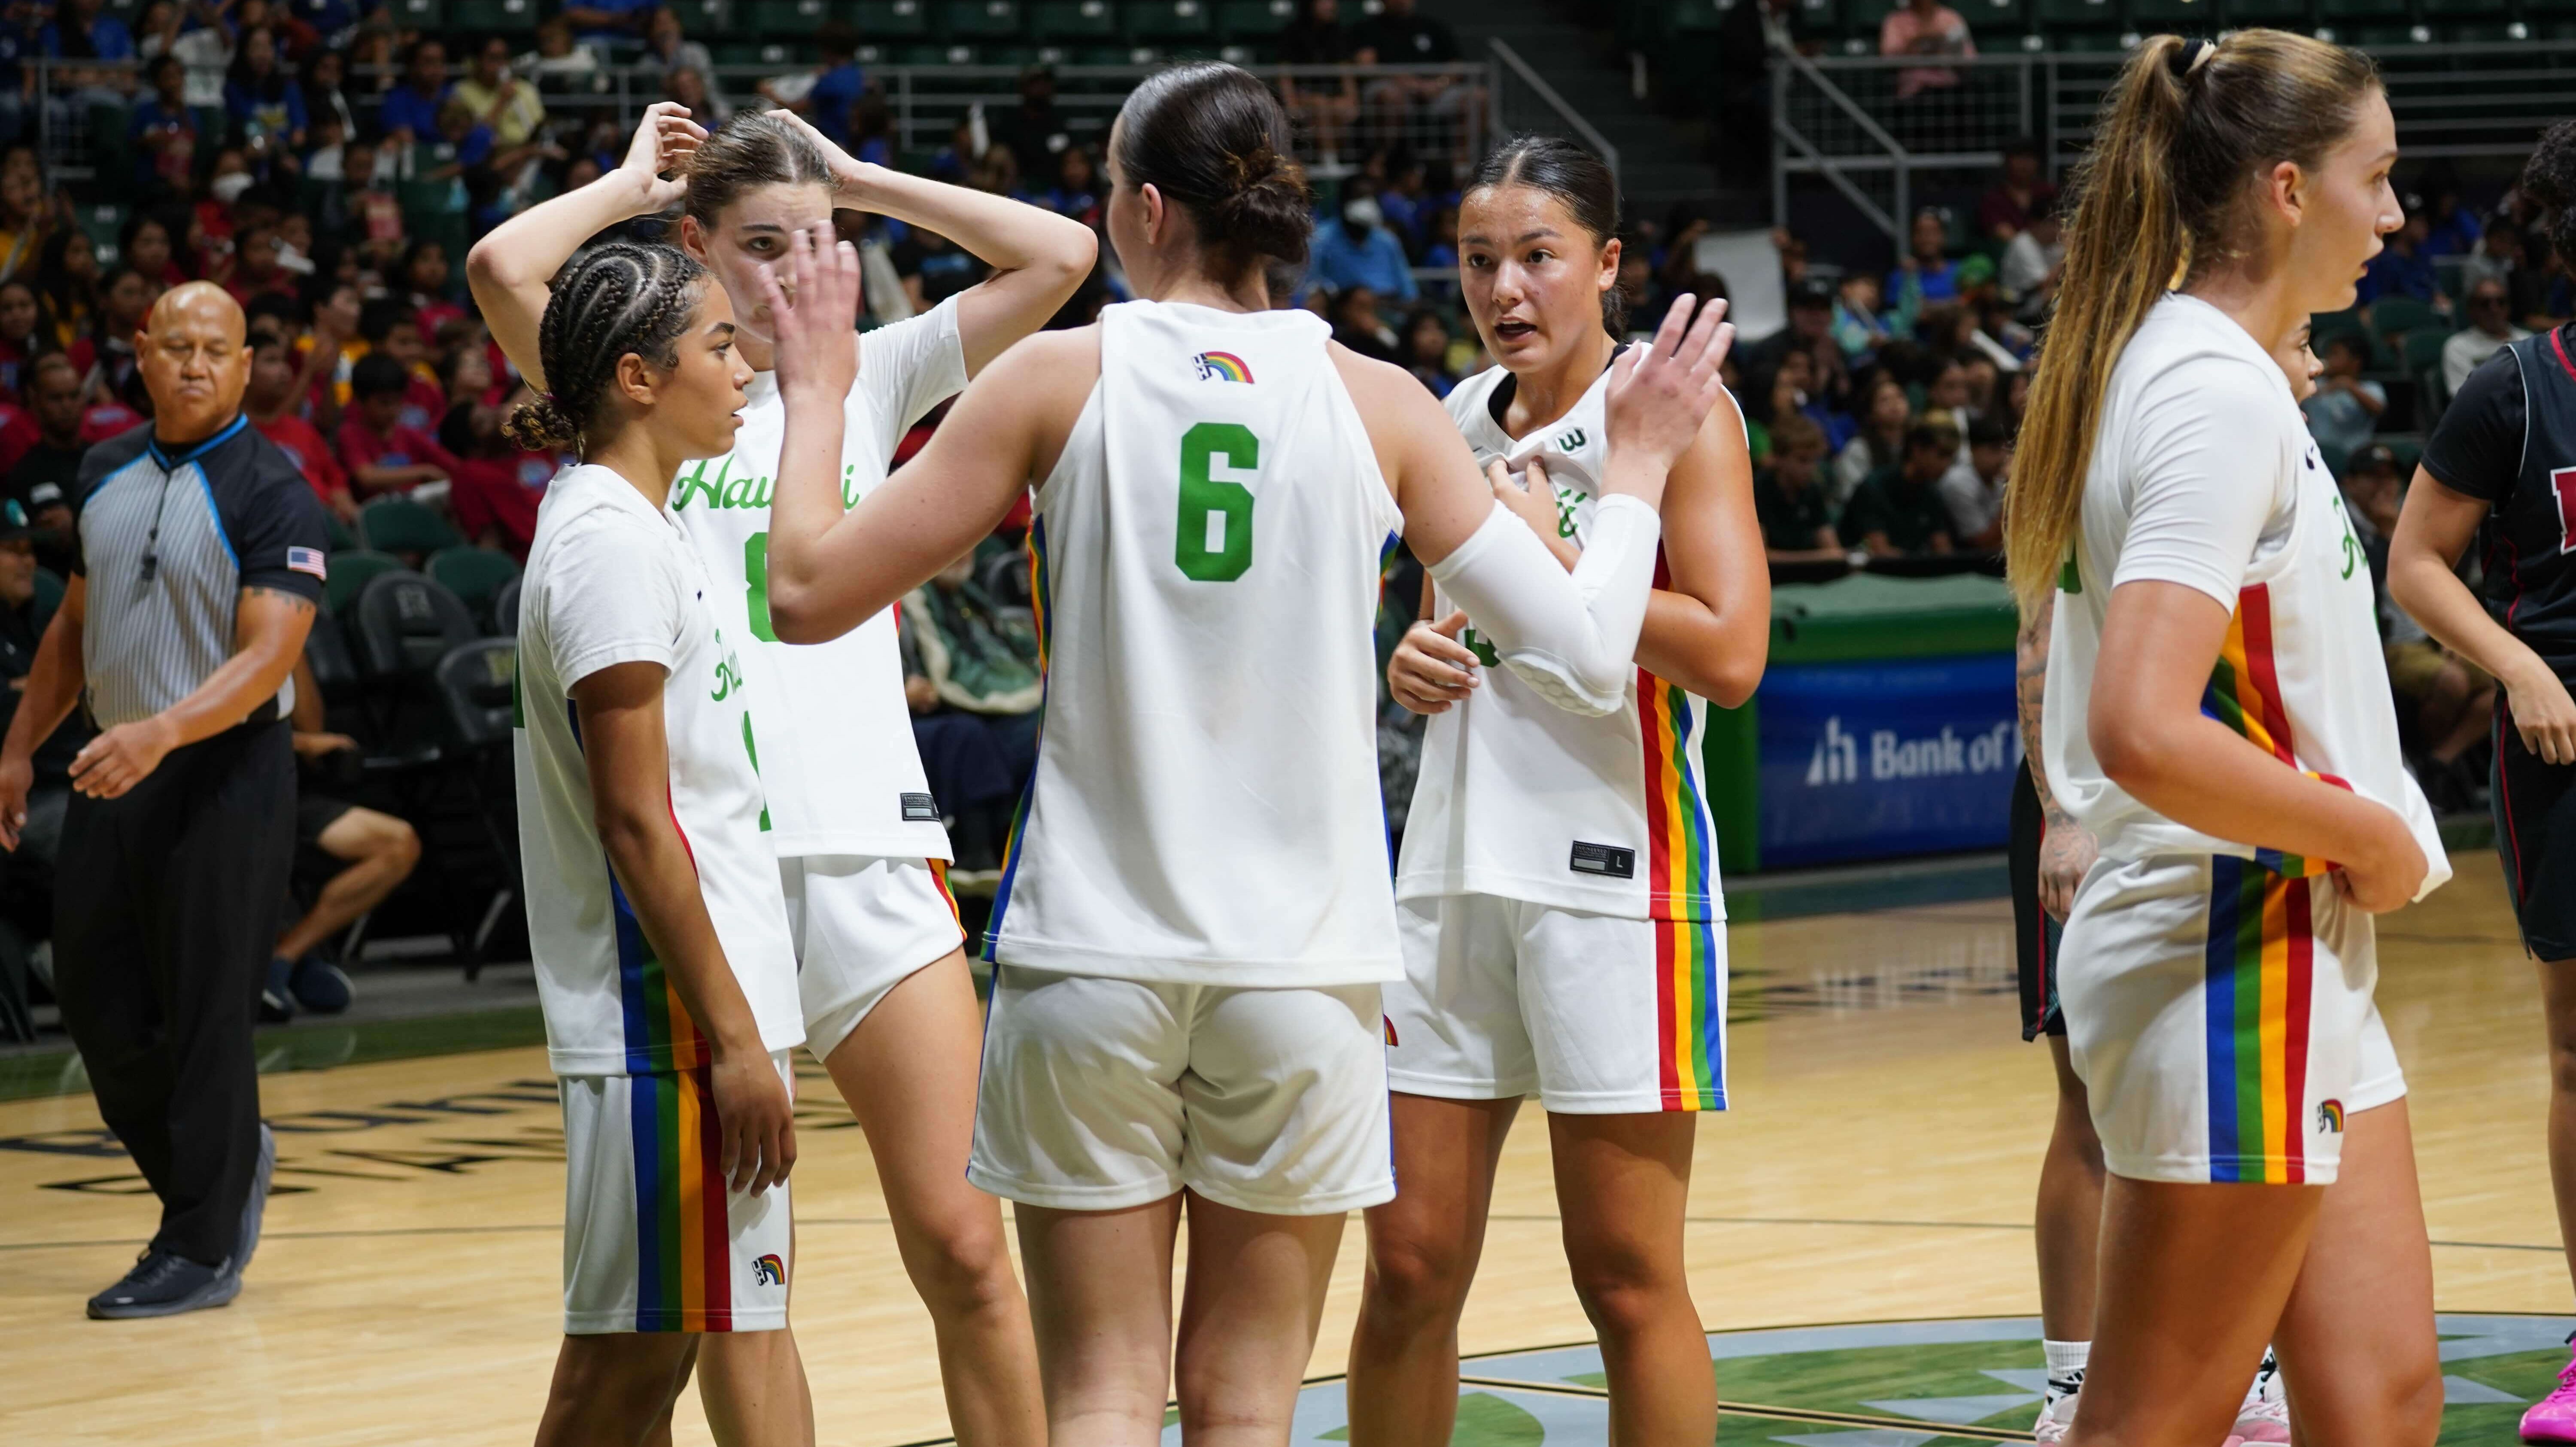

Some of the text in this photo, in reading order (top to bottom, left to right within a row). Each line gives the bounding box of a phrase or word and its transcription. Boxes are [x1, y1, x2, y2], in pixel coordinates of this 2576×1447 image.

[672, 453, 859, 511] Hawi
[1175, 422, 1259, 582] 6
[1872, 727, 1964, 780] Bank
[1969, 720, 2009, 772] of
[1616, 855, 1623, 868] L
